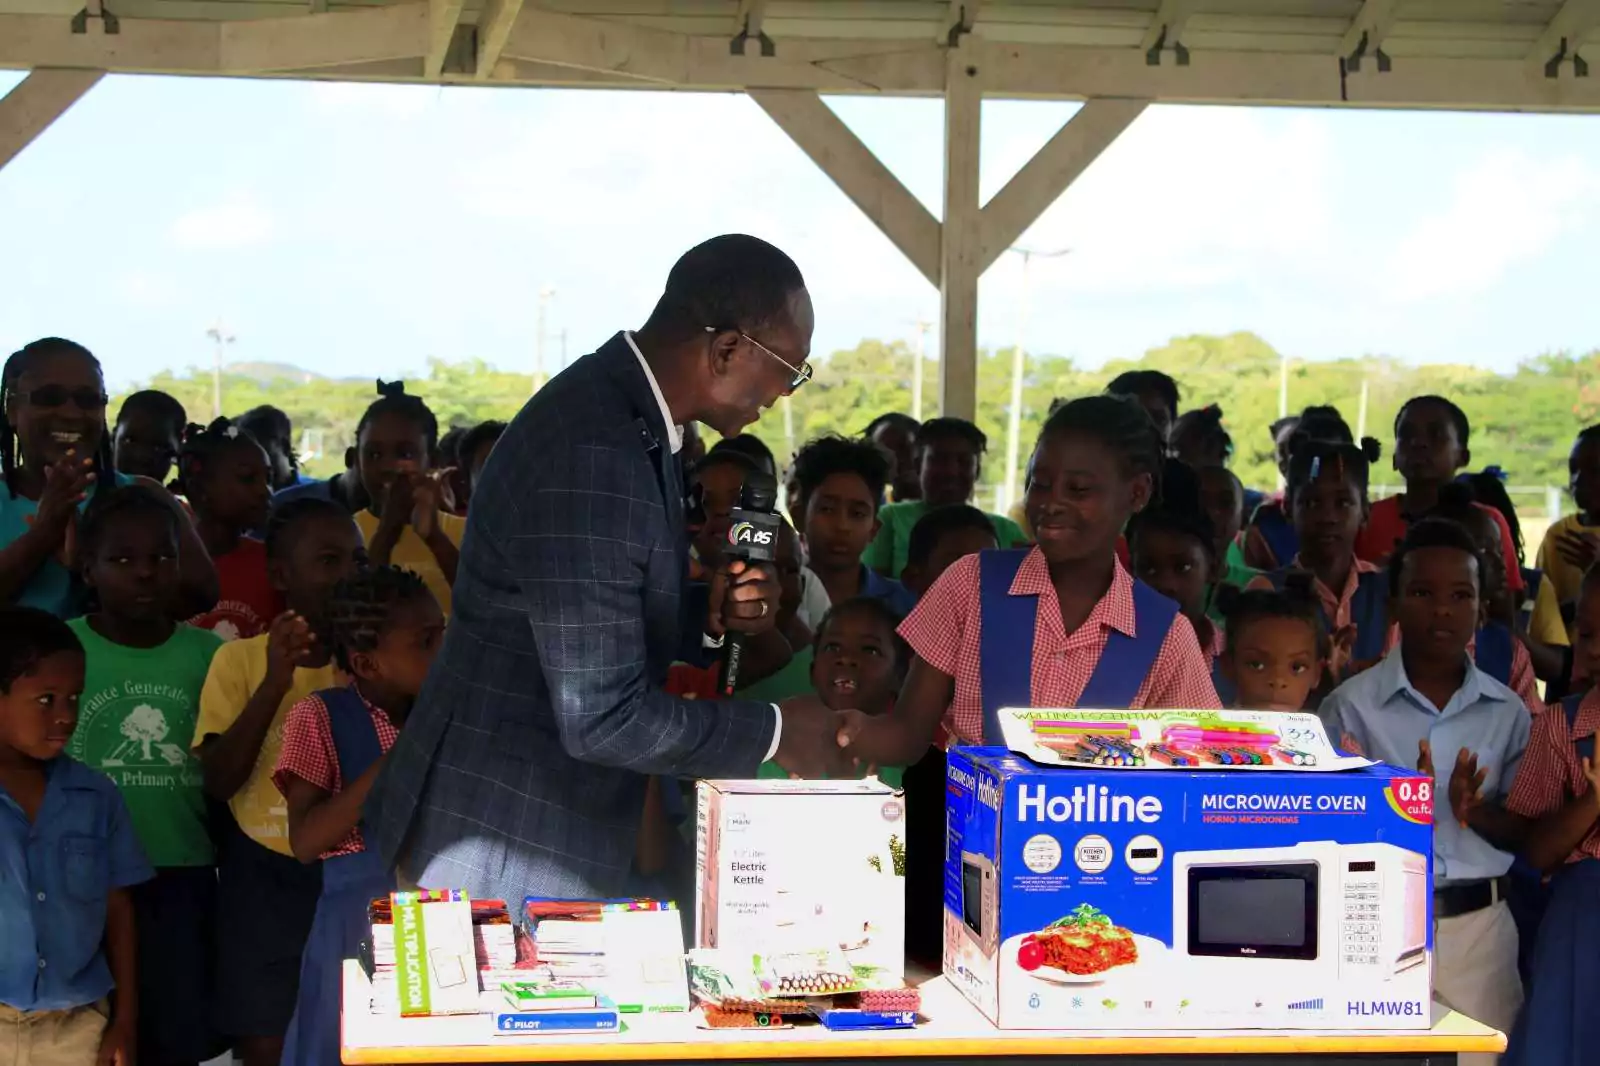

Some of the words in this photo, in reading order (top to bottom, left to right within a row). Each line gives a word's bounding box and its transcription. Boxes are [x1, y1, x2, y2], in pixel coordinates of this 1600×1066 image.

[122, 770, 176, 788] Primary
[1399, 782, 1430, 802] 0.8
[1018, 784, 1163, 823] Hotline
[1202, 794, 1312, 810] MICROWAVE
[1317, 795, 1366, 811] OVEN
[731, 861, 767, 872] Electric
[733, 875, 764, 885] Kettle
[1347, 1001, 1424, 1016] HLMW81
[514, 1021, 541, 1029] PILOT
